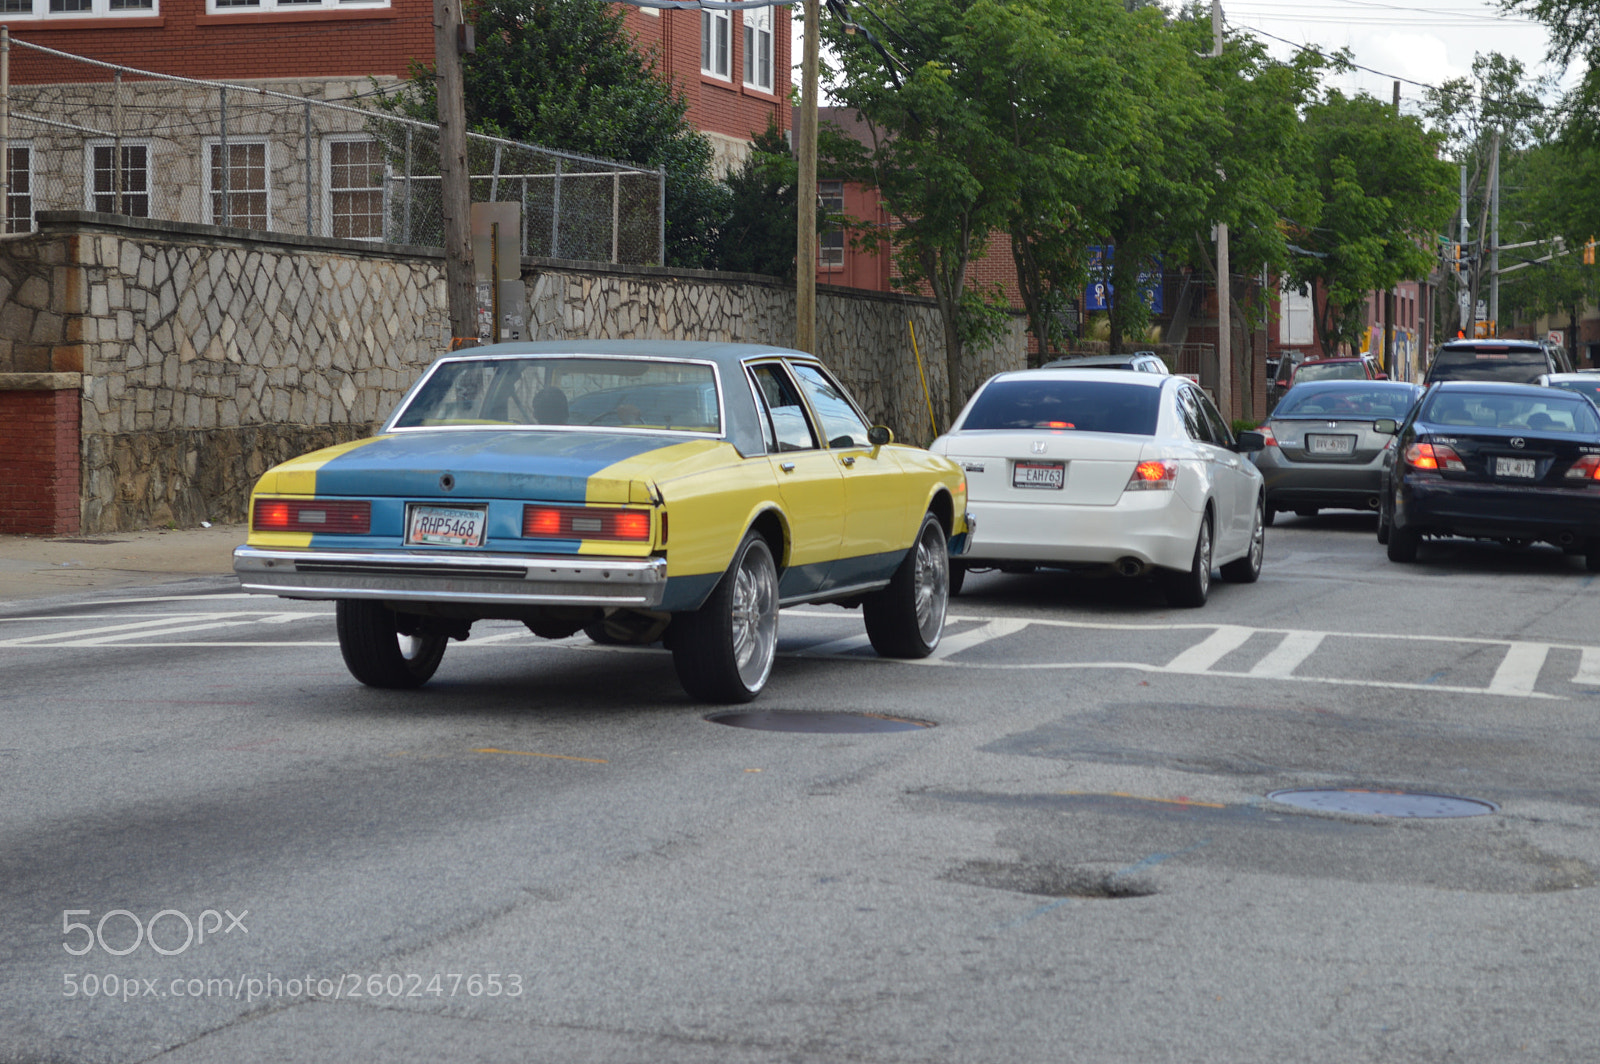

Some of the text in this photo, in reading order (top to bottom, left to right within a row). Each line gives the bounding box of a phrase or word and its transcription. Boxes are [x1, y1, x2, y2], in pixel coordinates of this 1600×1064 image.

[1026, 469, 1061, 483] EAH763
[443, 510, 480, 519] GEORGIA
[420, 516, 475, 537] RHP5468
